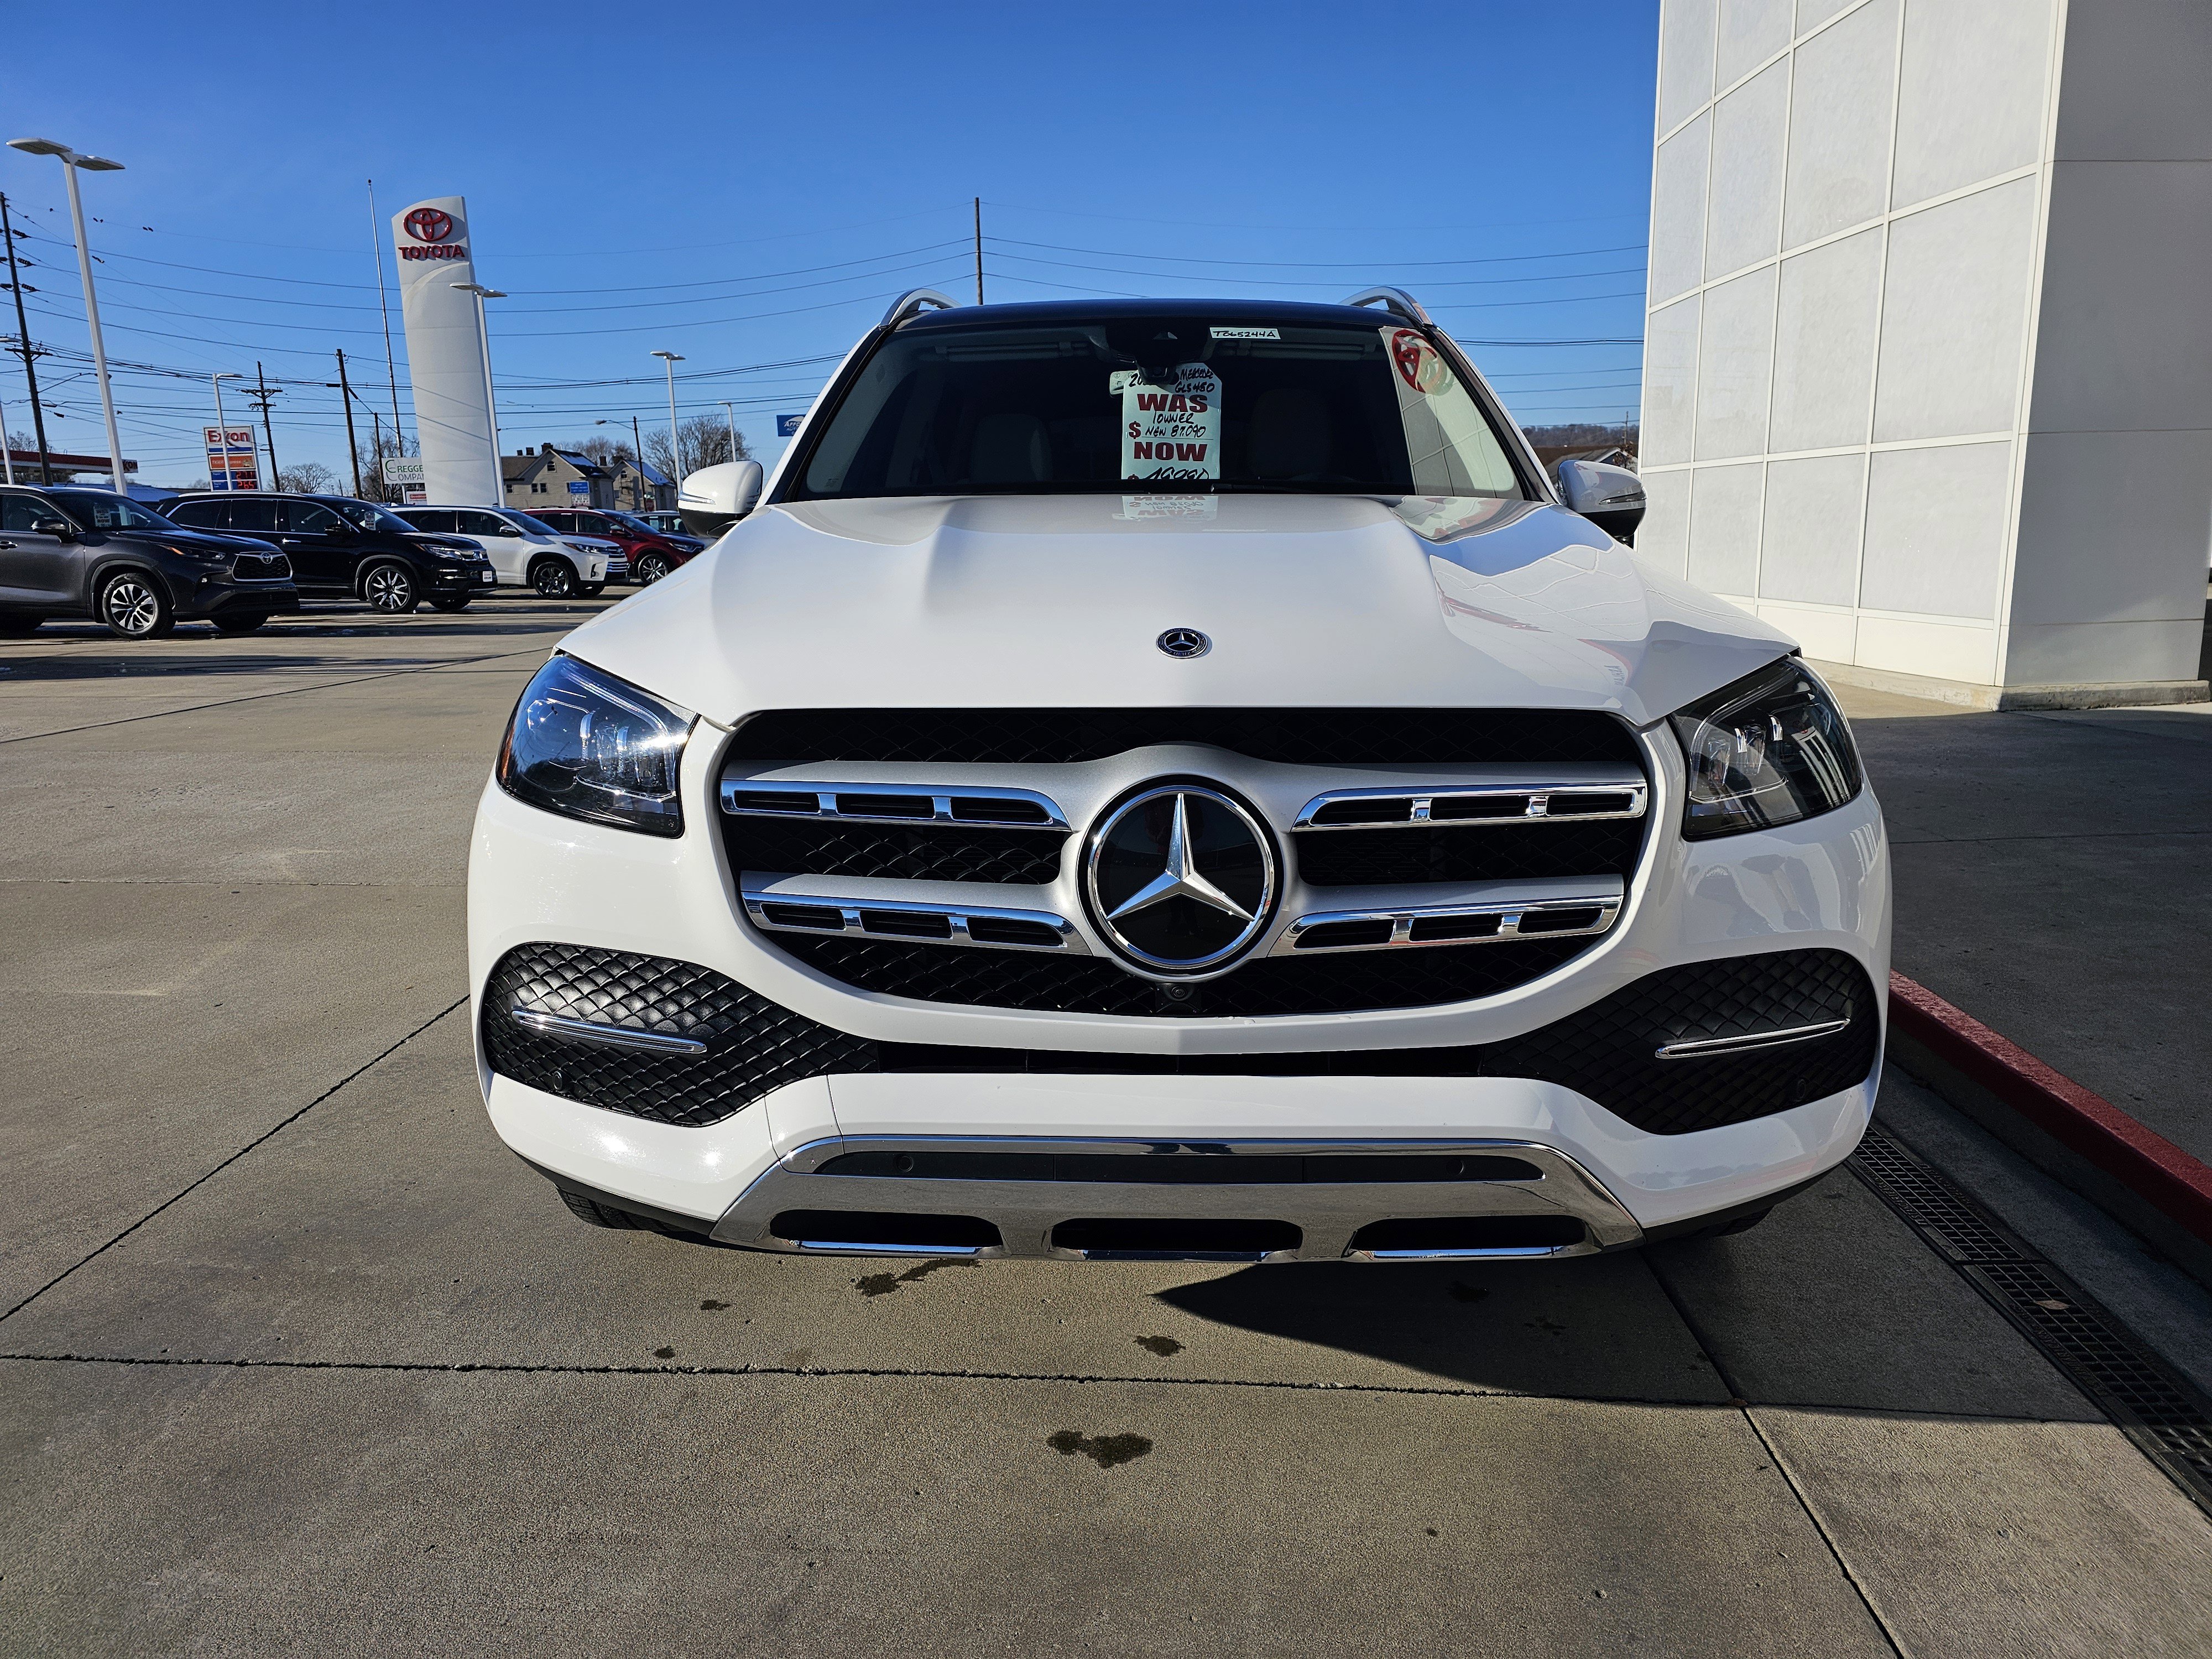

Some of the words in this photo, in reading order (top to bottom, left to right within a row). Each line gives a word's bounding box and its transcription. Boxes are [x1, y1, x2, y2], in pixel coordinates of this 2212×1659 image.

[398, 245, 465, 259] TOYOTA
[1137, 393, 1208, 413] WAS
[1134, 441, 1208, 461] NOW
[385, 460, 424, 473] CREGGE
